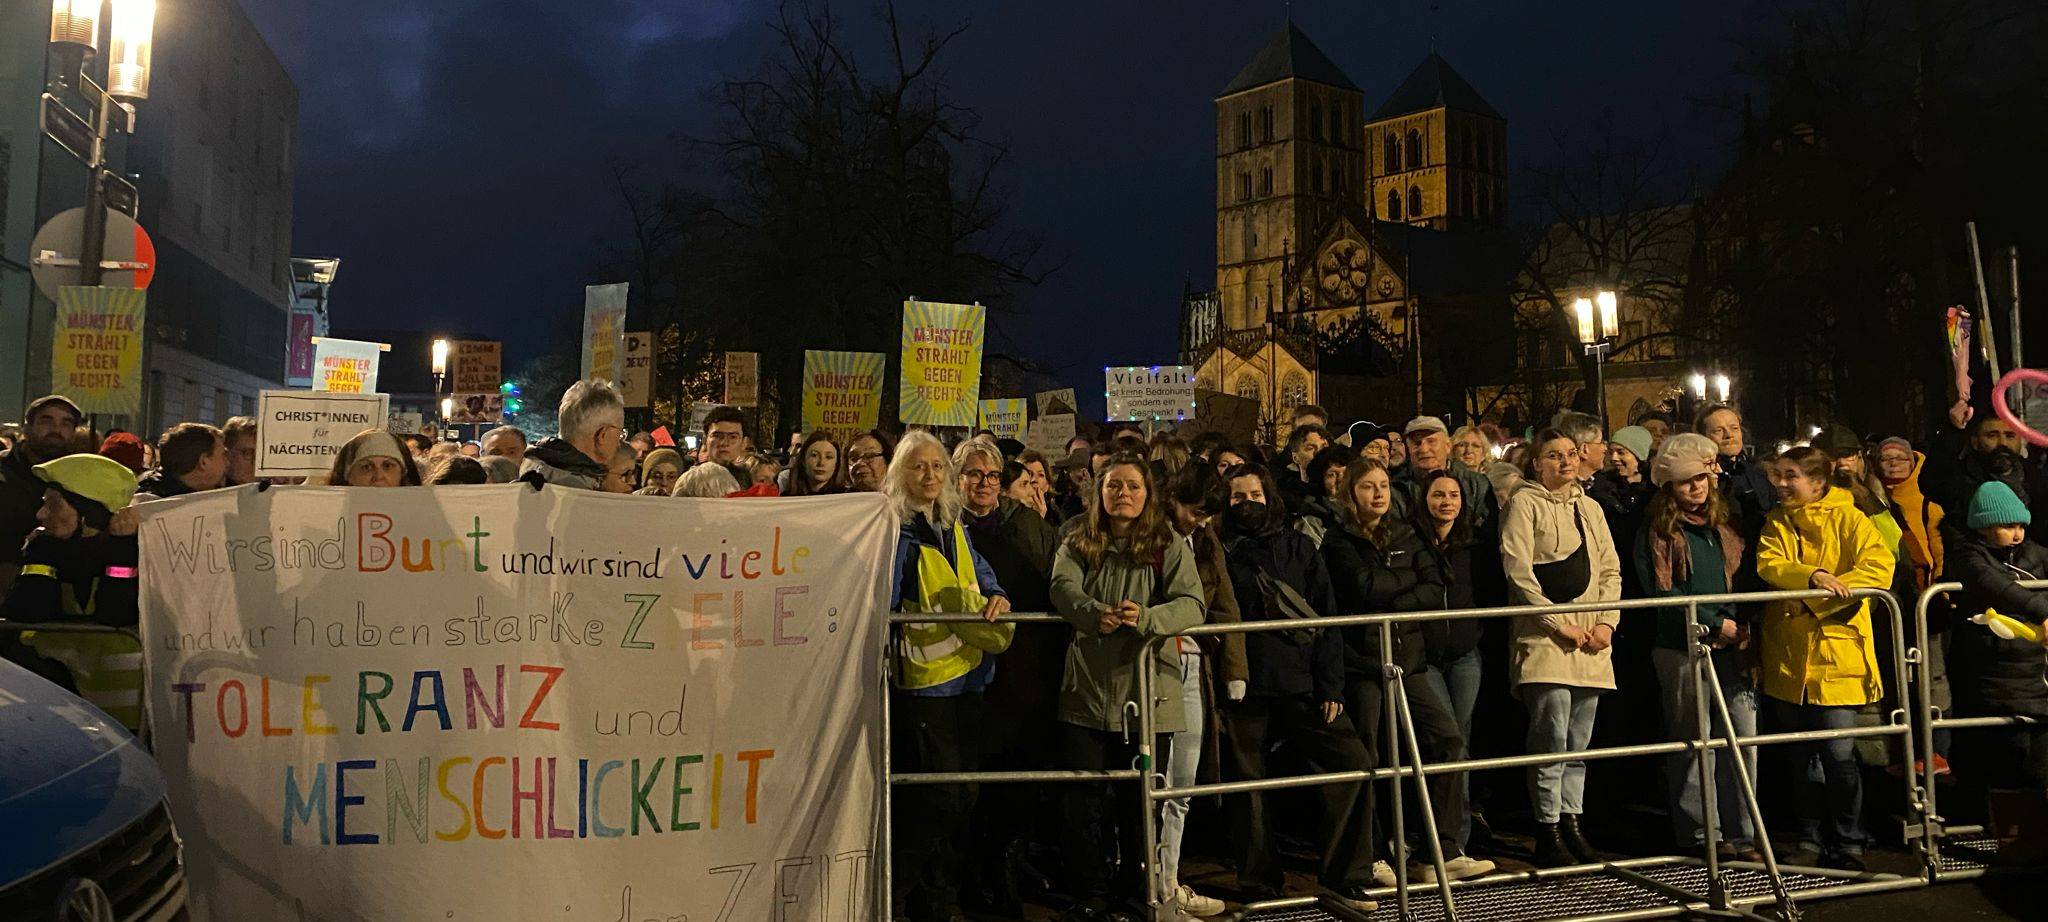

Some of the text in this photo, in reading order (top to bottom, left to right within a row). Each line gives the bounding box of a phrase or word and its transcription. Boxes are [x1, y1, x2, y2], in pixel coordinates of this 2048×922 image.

[67, 311, 134, 332] MÜNSTER
[68, 334, 128, 352] STRAHLT
[914, 325, 973, 346] MÜNSTER
[76, 354, 119, 370] GEGEN
[323, 355, 370, 371] MÜNSTER
[916, 347, 969, 365] STRAHLT
[324, 369, 367, 384] STRAHLT
[814, 372, 873, 391] MÜNSTER
[924, 367, 962, 384] GEGEN
[1115, 372, 1187, 385] Vielfalt
[329, 382, 360, 393] GEGEN
[917, 385, 964, 402] RECHTS.
[1121, 388, 1143, 397] keine
[815, 392, 870, 408] STRAHLT
[822, 410, 860, 424] GEGEN
[985, 411, 1021, 423] MÜNSTER
[1129, 408, 1174, 417] Geschenk!
[987, 423, 1019, 433] STRAHLT
[269, 441, 343, 456] NÄCHSTEN
[358, 512, 490, 572] Bunt
[602, 547, 664, 579] sind
[682, 526, 811, 580] viele
[293, 596, 430, 648] haben
[171, 664, 688, 743] TOLERANZ und
[282, 748, 775, 846] MENSCHLICKEIT
[708, 848, 873, 922] ZEIT
